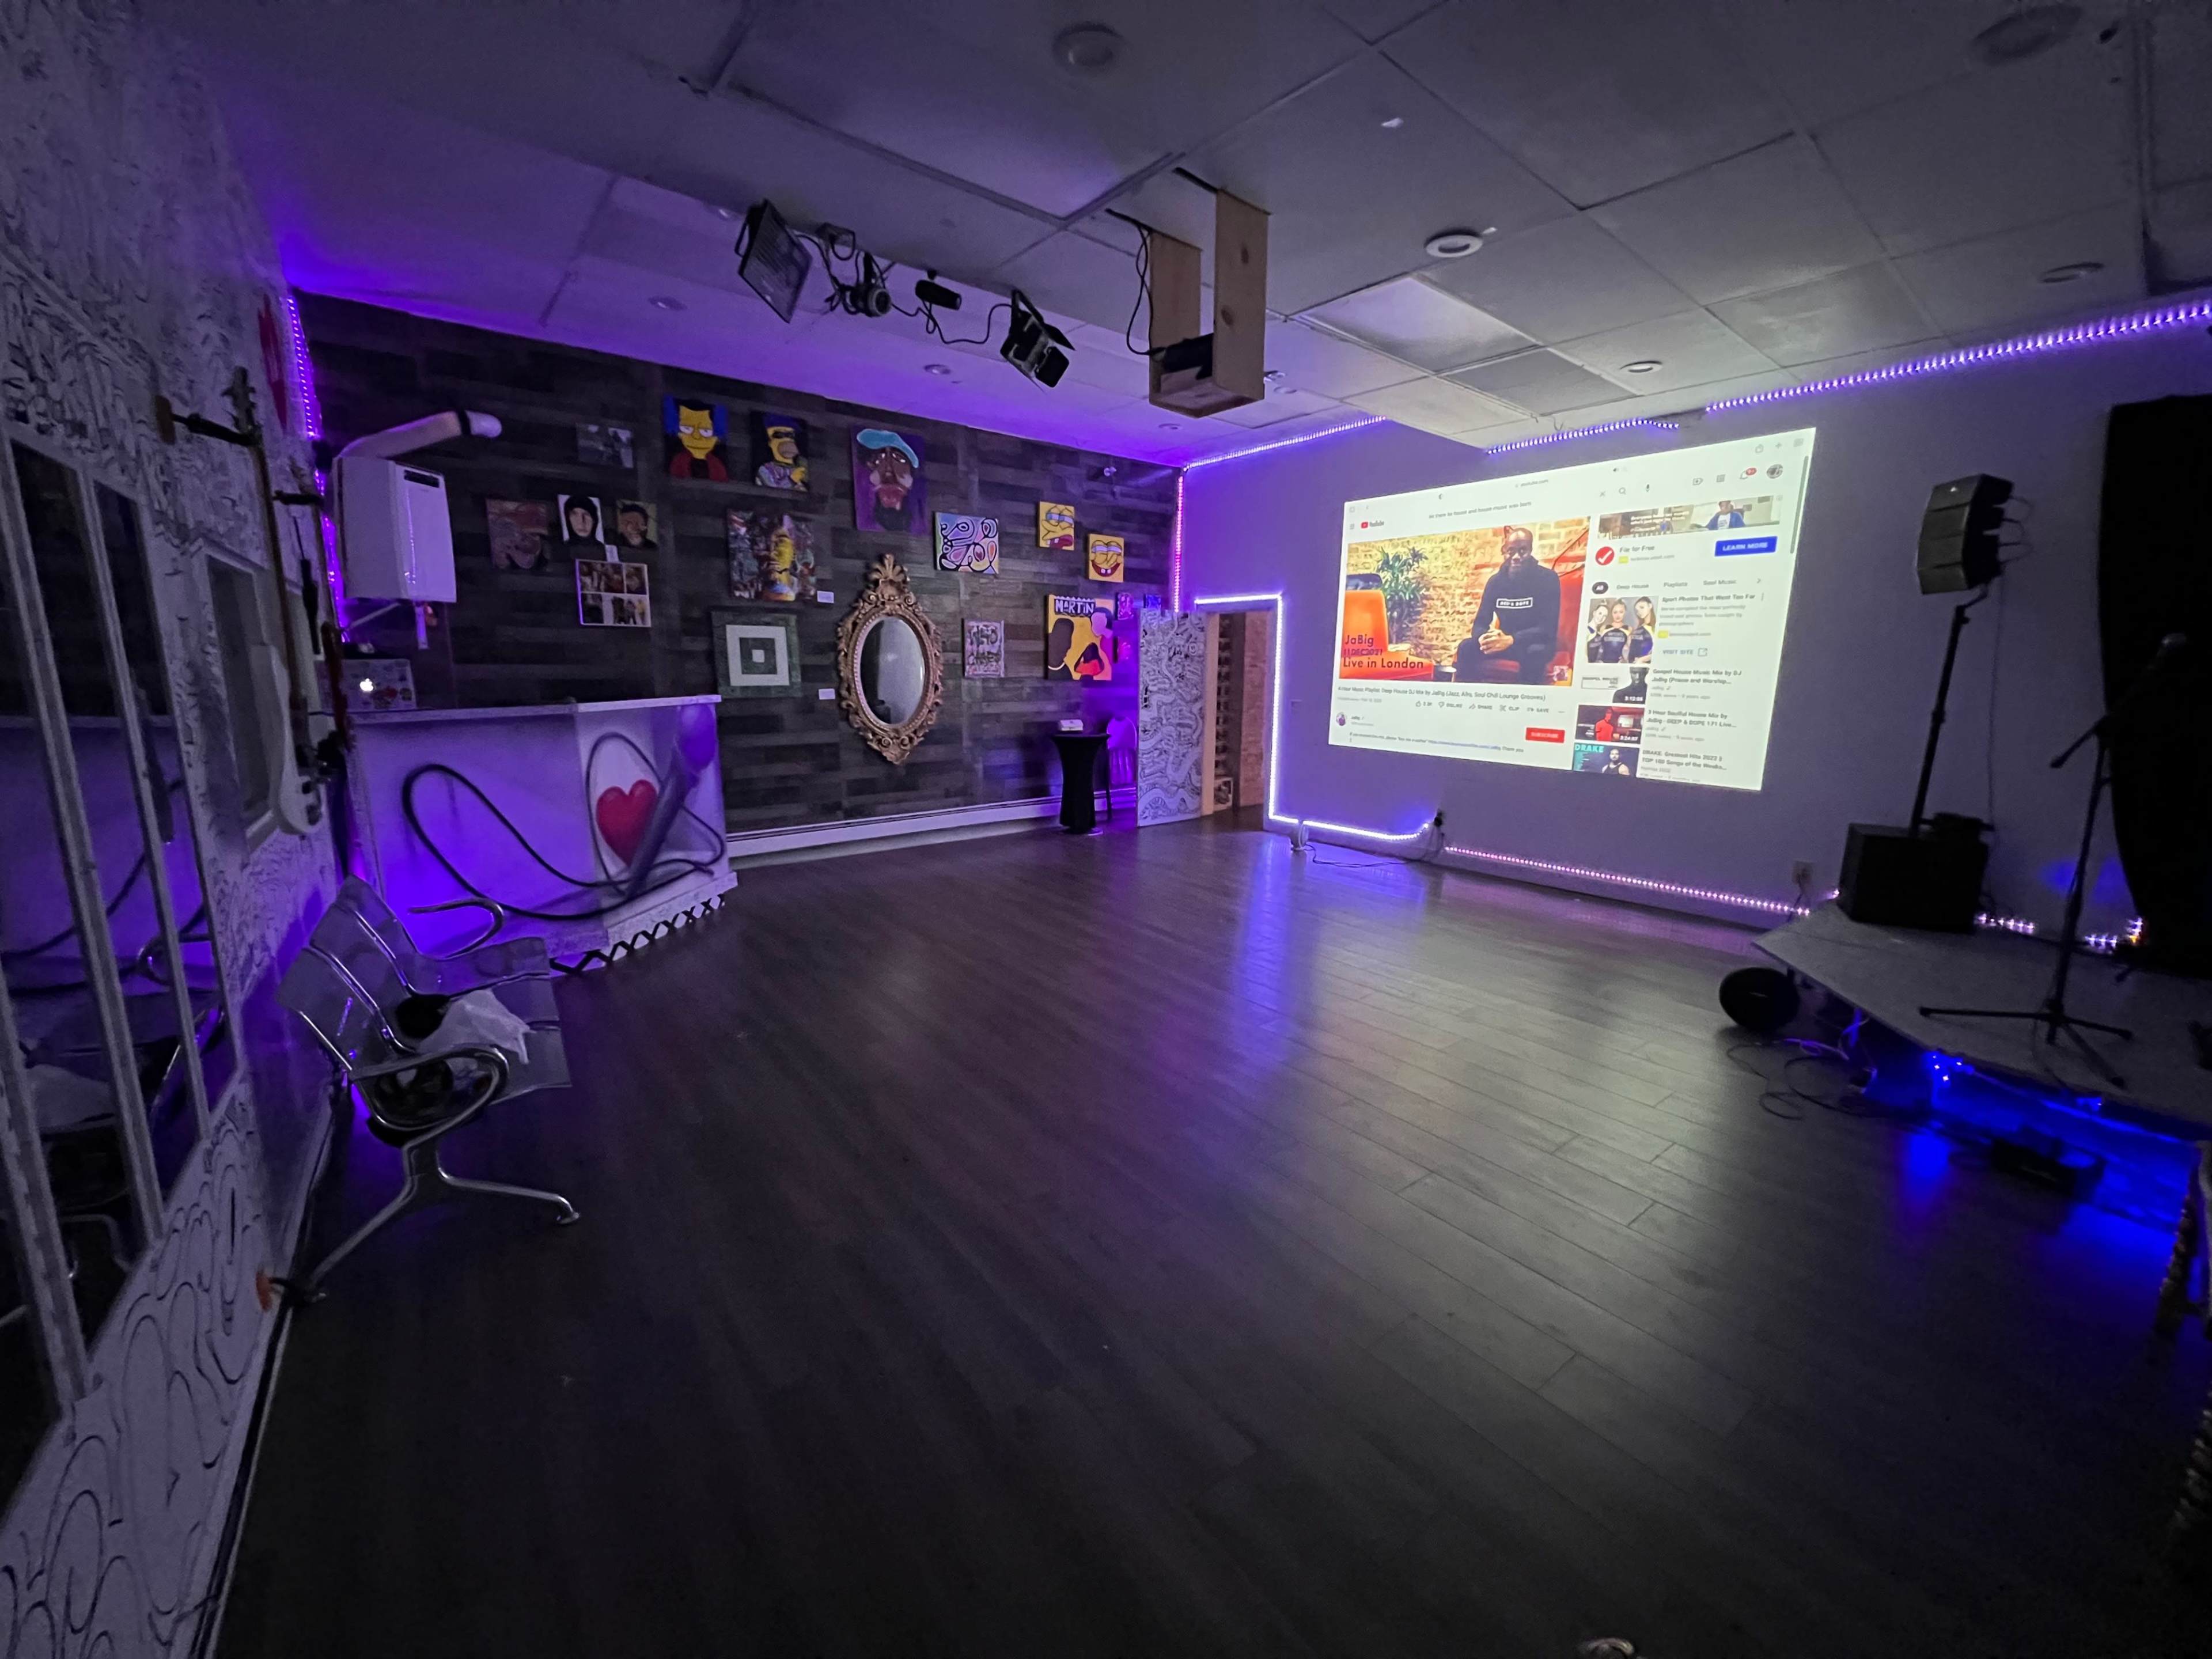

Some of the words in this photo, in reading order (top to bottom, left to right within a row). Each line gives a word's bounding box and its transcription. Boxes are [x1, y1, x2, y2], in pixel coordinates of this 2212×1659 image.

[1056, 600, 1094, 613] MARTIN
[1345, 634, 1374, 647] JaBig
[1343, 657, 1363, 668] Live
[1367, 657, 1377, 668] in
[1381, 657, 1423, 668] London
[1520, 694, 1546, 702] Grooves)
[1575, 744, 1604, 753] DRAKE
